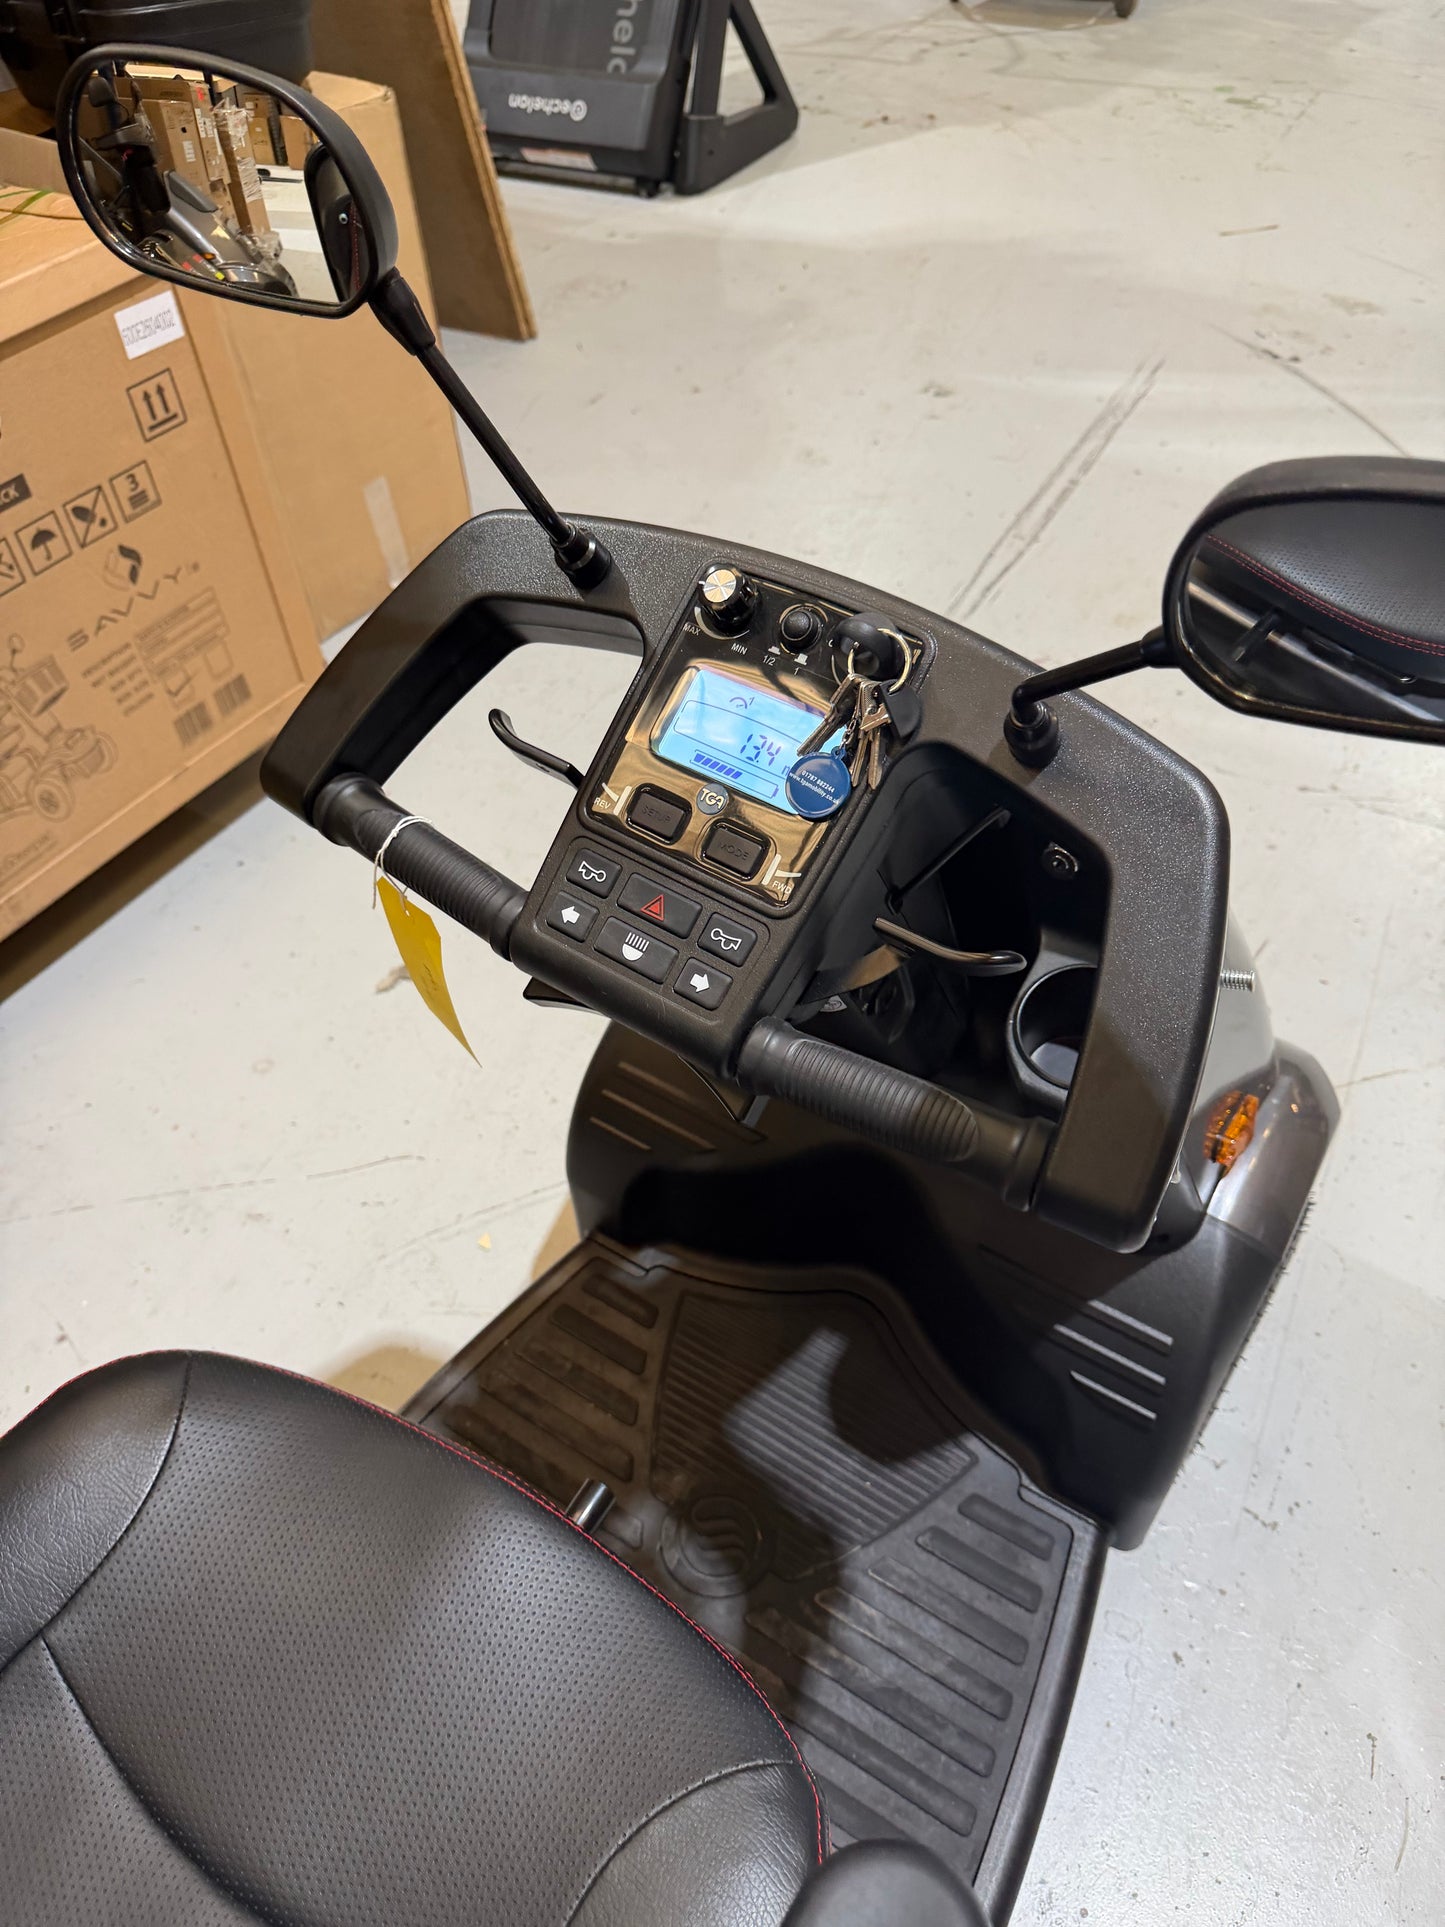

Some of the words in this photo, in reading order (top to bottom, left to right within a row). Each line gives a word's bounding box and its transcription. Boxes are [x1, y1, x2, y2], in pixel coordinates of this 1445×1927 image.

[126, 473, 139, 492] 3
[682, 621, 701, 636] MAX
[731, 642, 748, 655] MIN
[762, 654, 776, 666] 1/2
[793, 666, 800, 676] 1
[594, 797, 611, 810] REV
[700, 787, 725, 809] TGA
[772, 881, 794, 894] FWD
